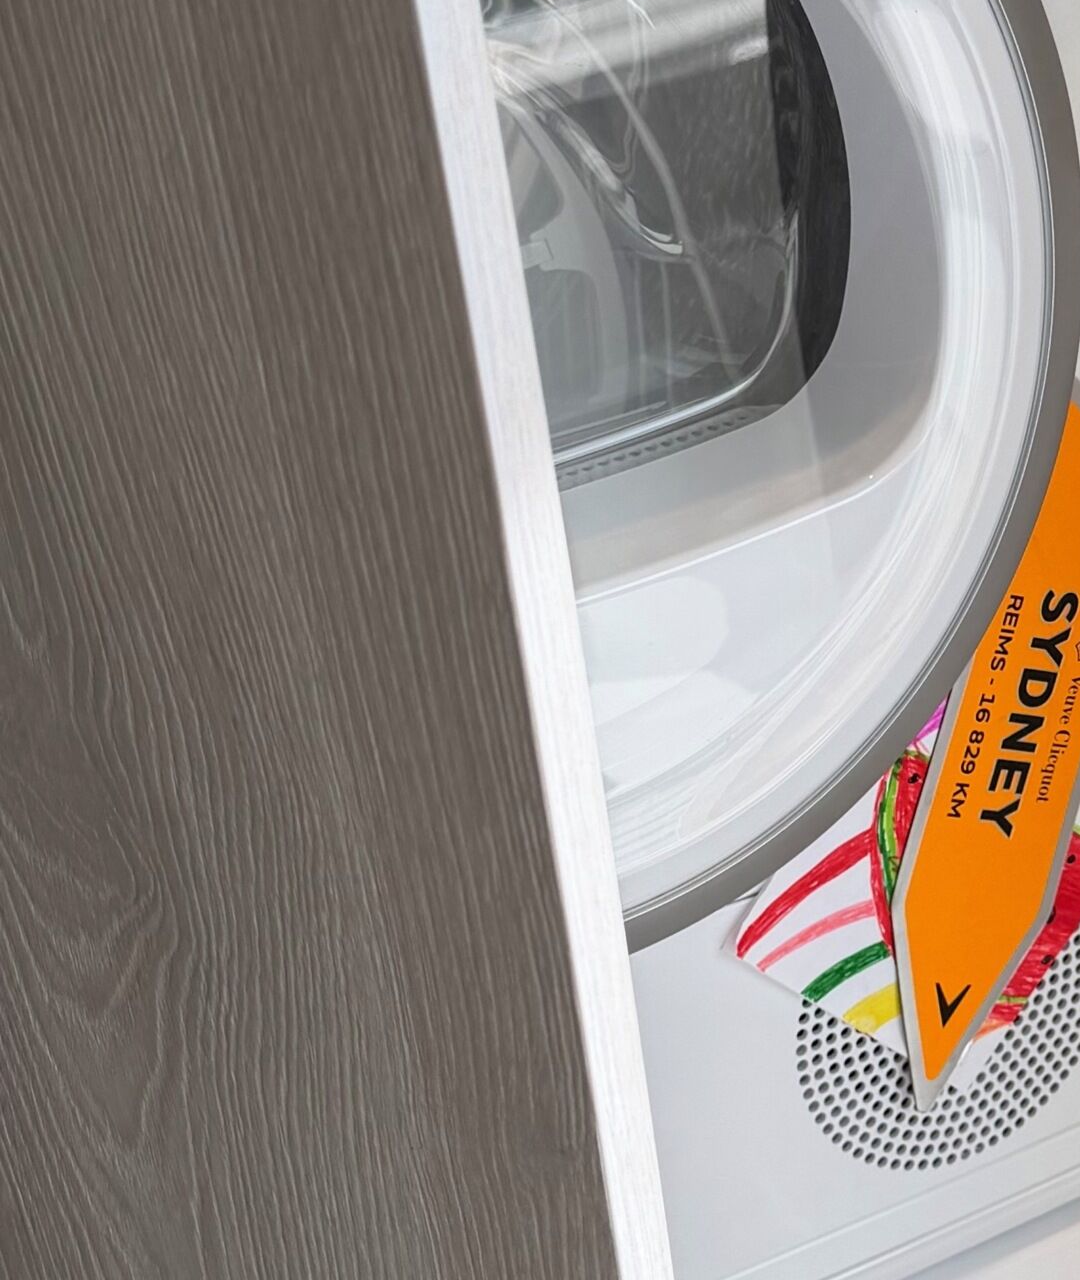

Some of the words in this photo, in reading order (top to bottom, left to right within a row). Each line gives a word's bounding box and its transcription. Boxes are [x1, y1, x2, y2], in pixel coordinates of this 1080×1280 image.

[990, 594, 1025, 671] REIMS
[975, 693, 996, 723] 16
[979, 589, 1080, 838] SYDNEY
[960, 729, 985, 775] 829
[1036, 728, 1071, 803] Clicquot
[947, 782, 970, 819] KM
